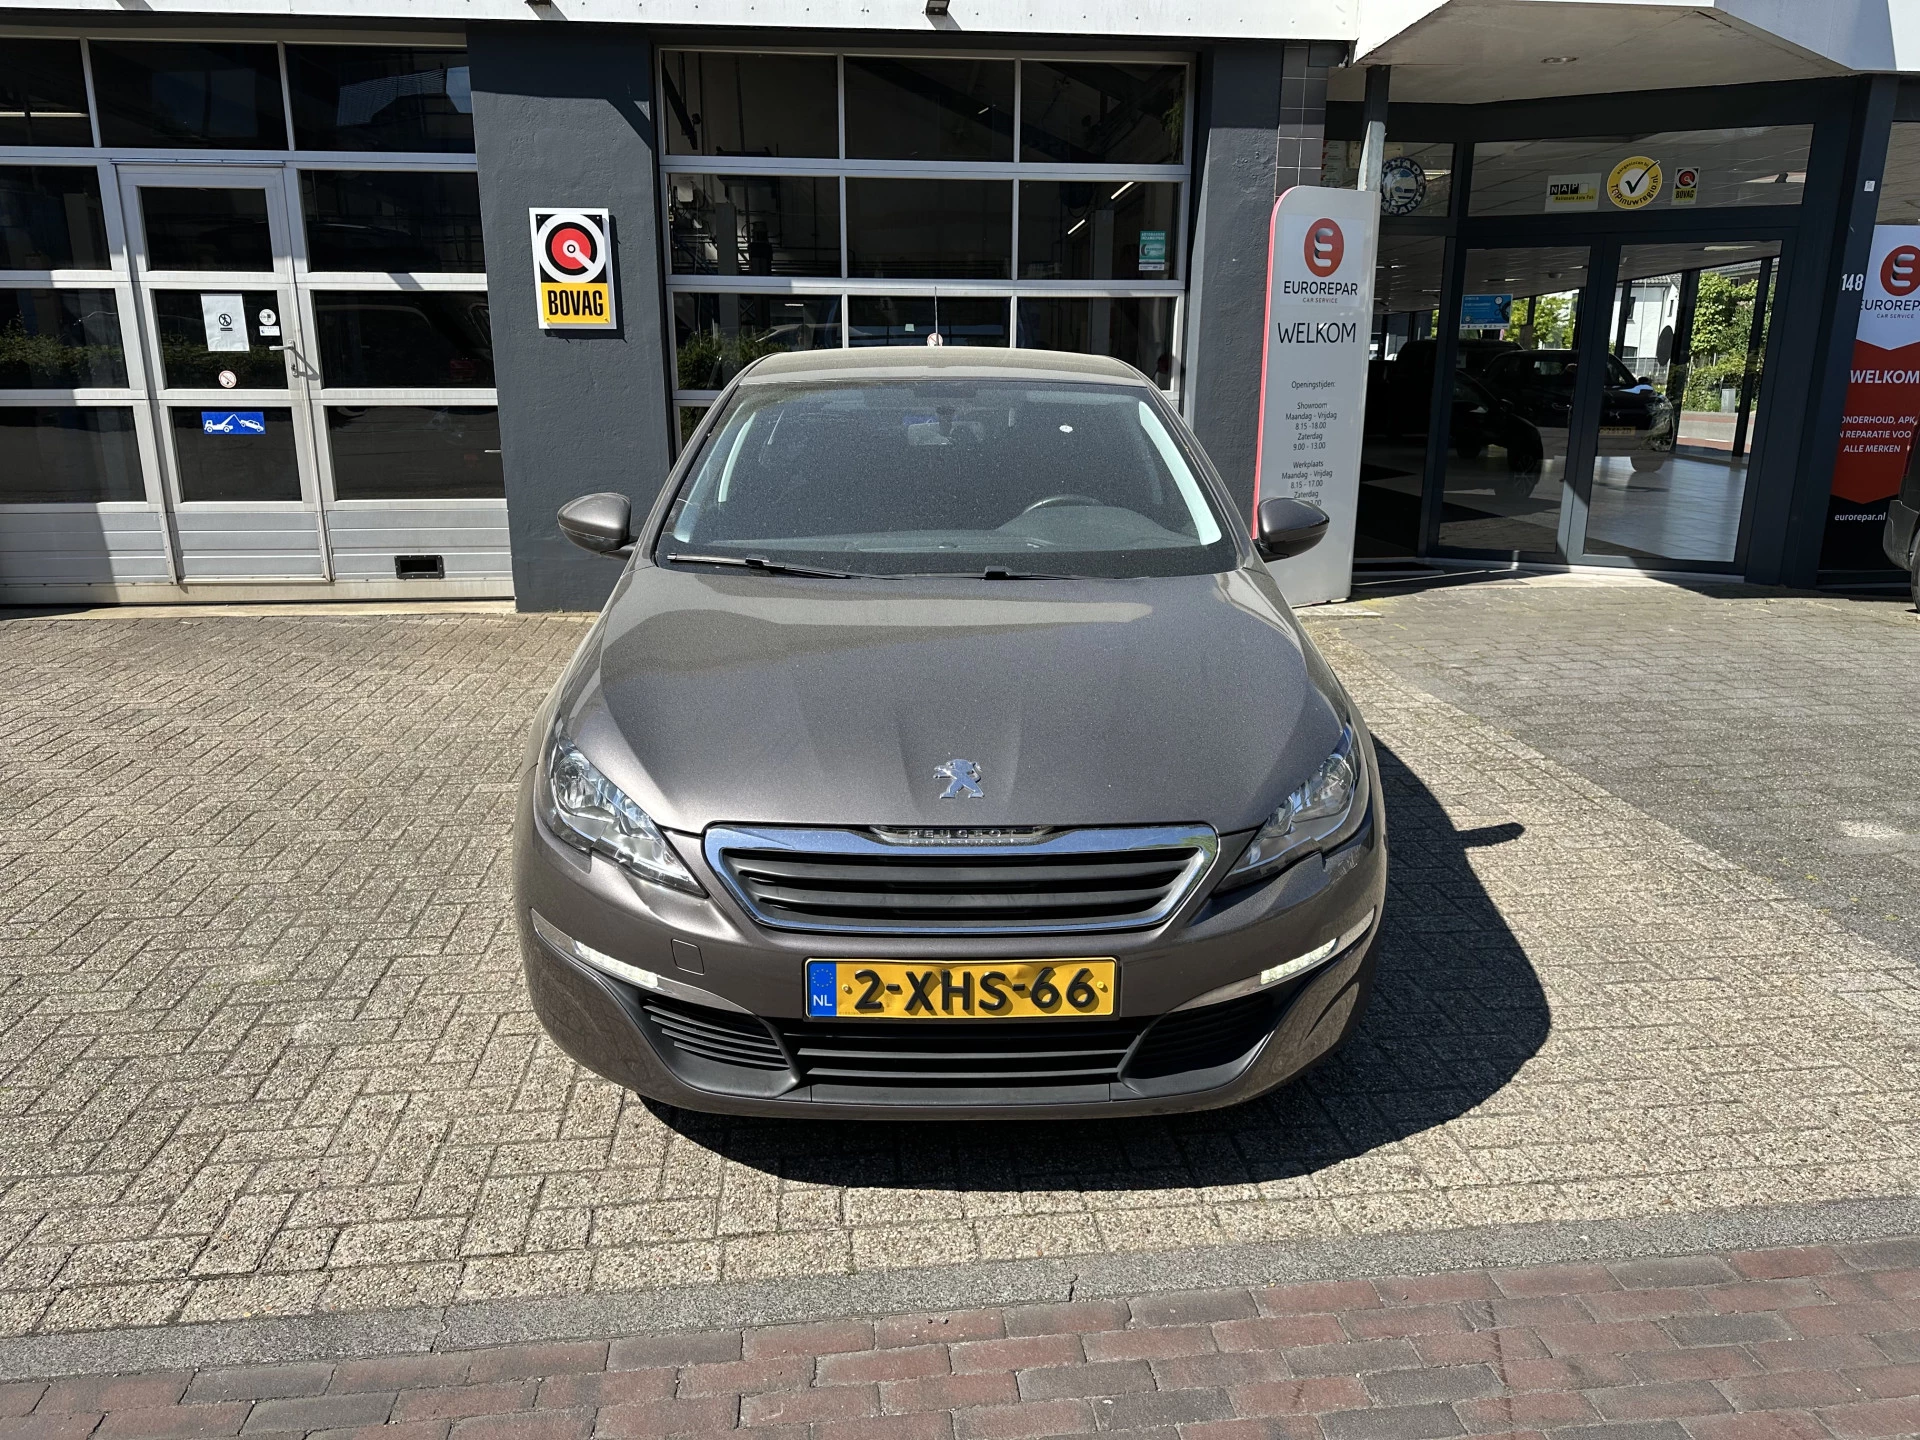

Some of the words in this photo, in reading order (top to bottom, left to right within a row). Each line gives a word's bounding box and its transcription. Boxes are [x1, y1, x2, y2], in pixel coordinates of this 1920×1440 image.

[1551, 183, 1578, 195] NAP
[1675, 190, 1695, 199] BOVAG
[1841, 273, 1864, 291] 148
[1283, 280, 1358, 296] EUROREPAR
[547, 290, 604, 316] BOVAG
[1860, 299, 1920, 311] UROREP
[1277, 322, 1356, 344] WELKOM
[1850, 369, 1920, 384] WELKOM
[1297, 401, 1328, 410] Showroom
[1285, 412, 1312, 421] Maandag
[1317, 411, 1338, 421] Vrijdag
[1295, 422, 1308, 430] 8.15
[1297, 431, 1323, 441] Zaterdag
[1845, 430, 1891, 438] REPARATIE
[1892, 430, 1912, 438] VOO
[1292, 443, 1306, 451] 9.00
[1311, 441, 1326, 450] 13.00
[1843, 444, 1865, 453] ALLE
[1865, 444, 1901, 453] MERKEN
[1292, 460, 1324, 469] Werkplaats
[1281, 471, 1308, 480] Maandag
[1313, 469, 1333, 479] Vrijdag
[1290, 481, 1303, 489] 8.15
[1308, 479, 1324, 488] 17.00
[1293, 490, 1319, 499] Zaterdag
[1834, 511, 1887, 523] eurorepar.nl
[813, 994, 833, 1008] NL
[855, 967, 1096, 1011] 2-XHS-66
